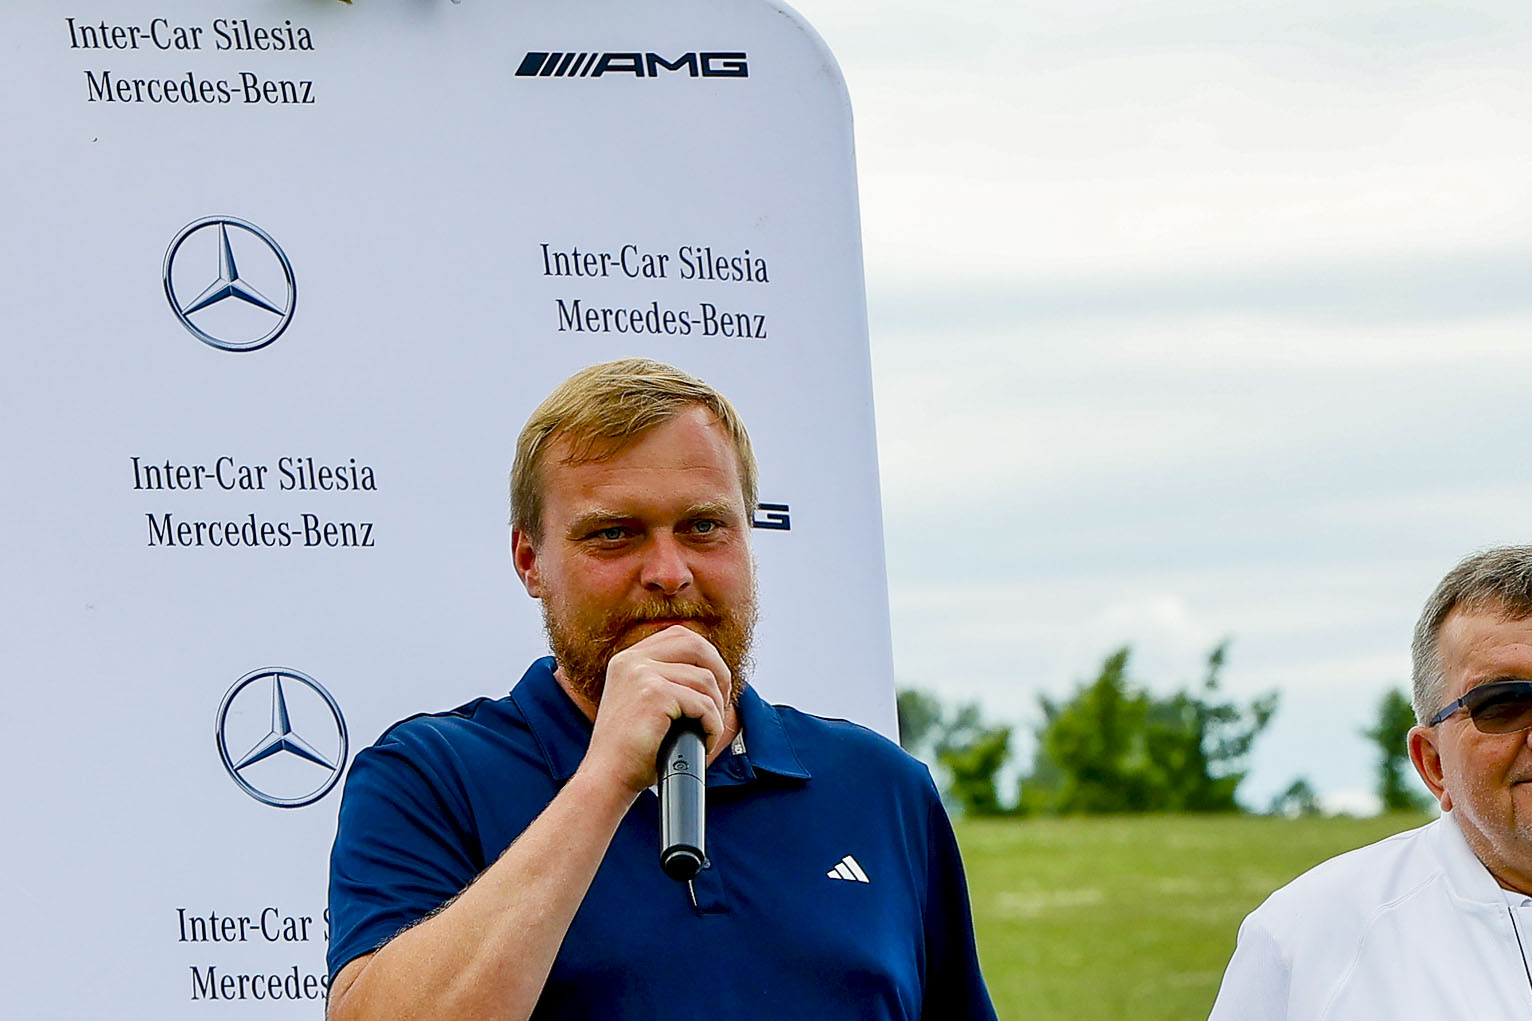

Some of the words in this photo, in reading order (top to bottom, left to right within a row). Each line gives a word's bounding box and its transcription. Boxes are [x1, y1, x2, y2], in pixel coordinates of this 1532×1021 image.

[66, 18, 202, 50] Inter-Car
[213, 19, 315, 51] Silesia
[596, 52, 749, 78] AMG
[84, 71, 315, 104] Mercedes-Benz
[540, 244, 669, 279] Inter-Car
[679, 247, 769, 283] Silesia
[556, 300, 767, 339] Mercedes-Benz
[131, 457, 267, 490] Inter-Car
[279, 457, 377, 491] Silesia
[146, 514, 375, 547] Mercedes-Benz
[176, 908, 312, 941] Inter-Car
[190, 965, 329, 1000] Mercedes
